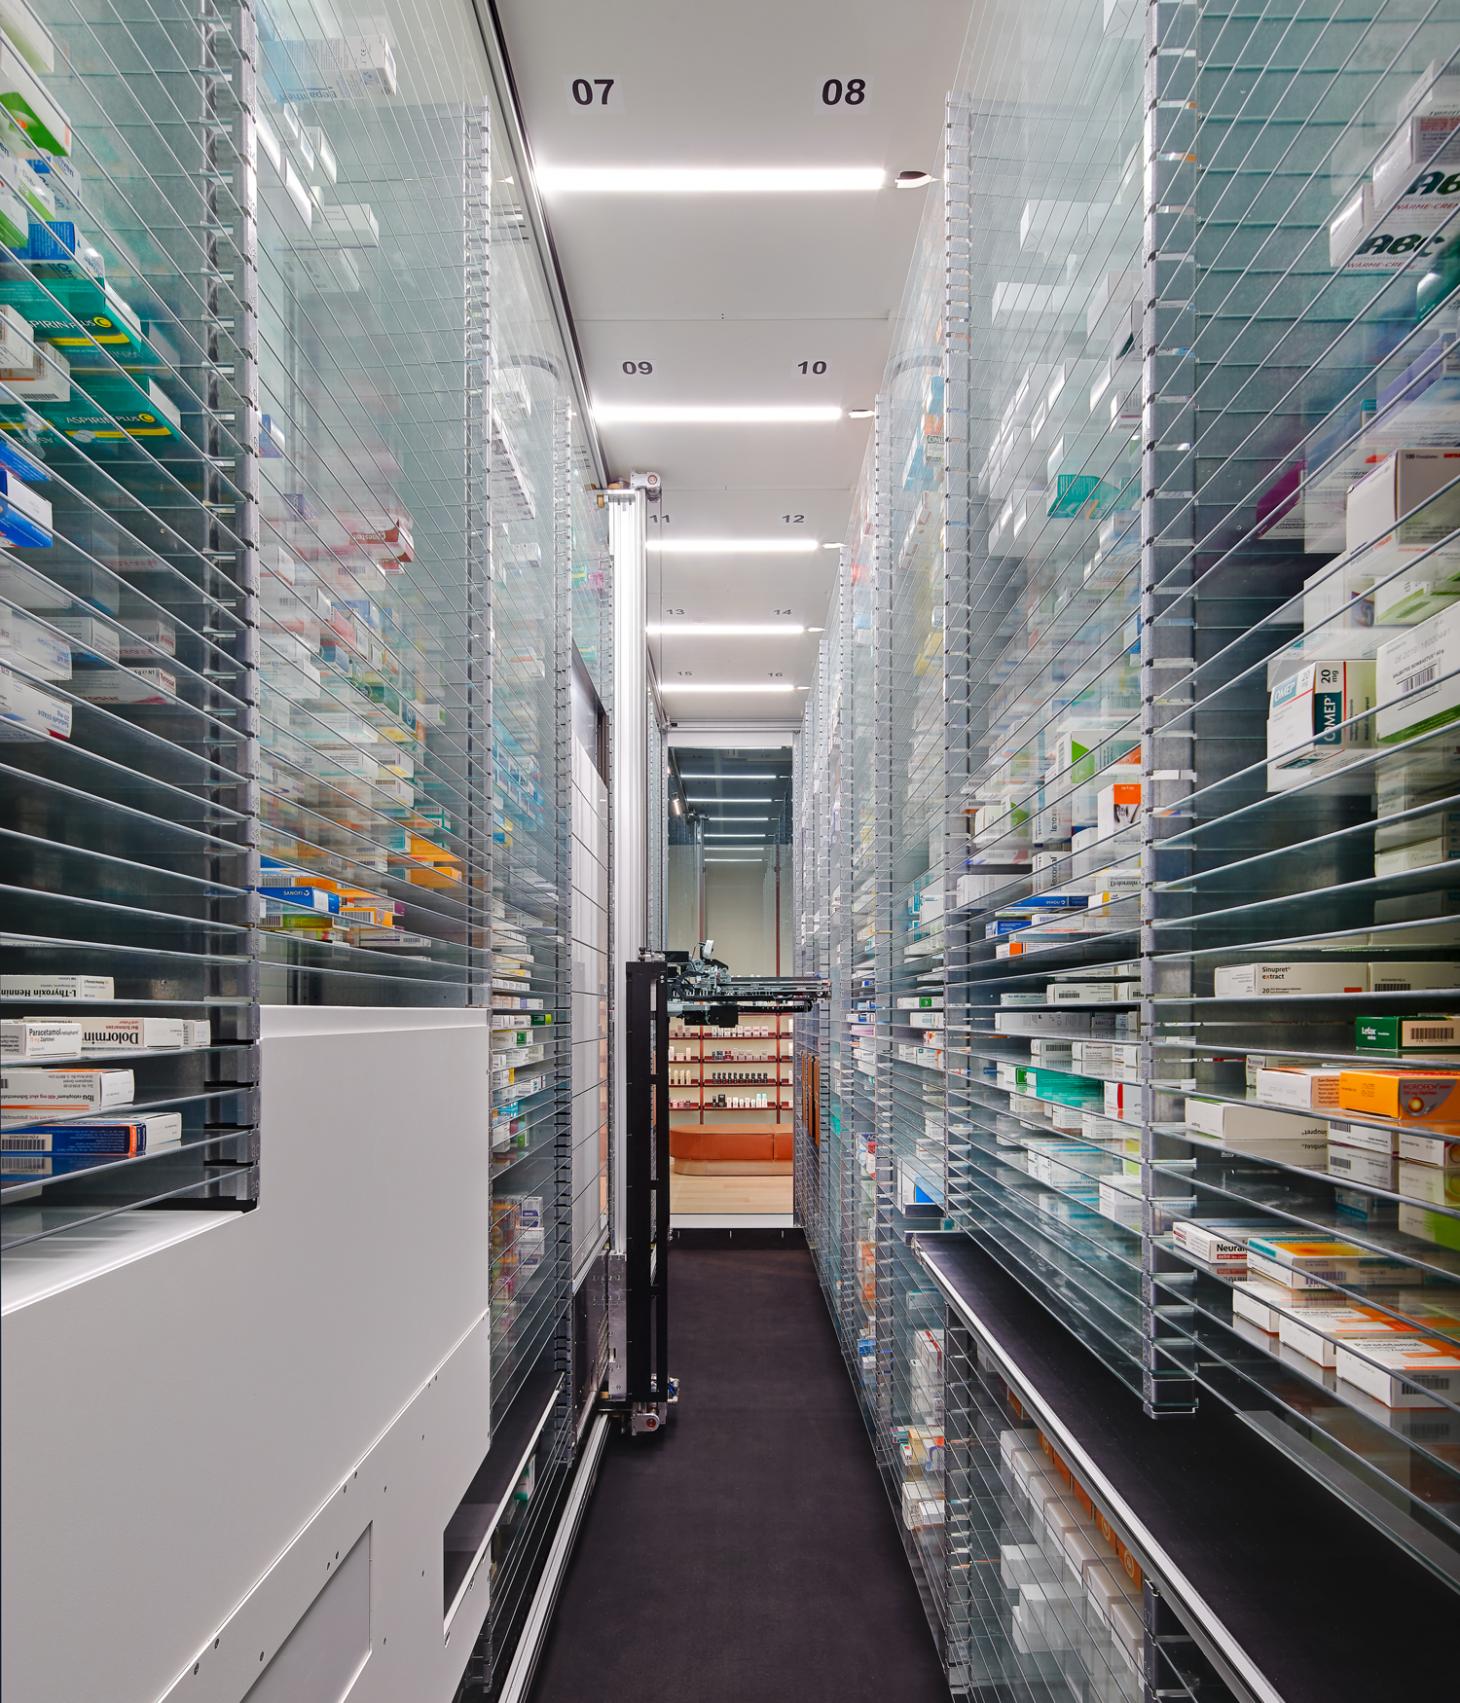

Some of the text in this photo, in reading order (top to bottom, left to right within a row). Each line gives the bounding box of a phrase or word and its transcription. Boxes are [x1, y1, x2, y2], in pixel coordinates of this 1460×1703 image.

[571, 78, 615, 106] 07
[821, 78, 867, 106] 08
[1355, 232, 1445, 258] ABC
[622, 360, 654, 376] 09
[797, 360, 828, 376] 10
[649, 513, 671, 524] 11
[781, 513, 806, 524] 12
[666, 608, 686, 616] 13
[773, 608, 793, 616] 14
[1321, 668, 1340, 684] 20 mg
[1323, 695, 1337, 743] OMEP
[33, 988, 77, 998] L-Thyroxin
[29, 1028, 61, 1036] Paracetamol
[83, 1030, 139, 1045] Dolormin
[82, 1094, 94, 1102] Ibu
